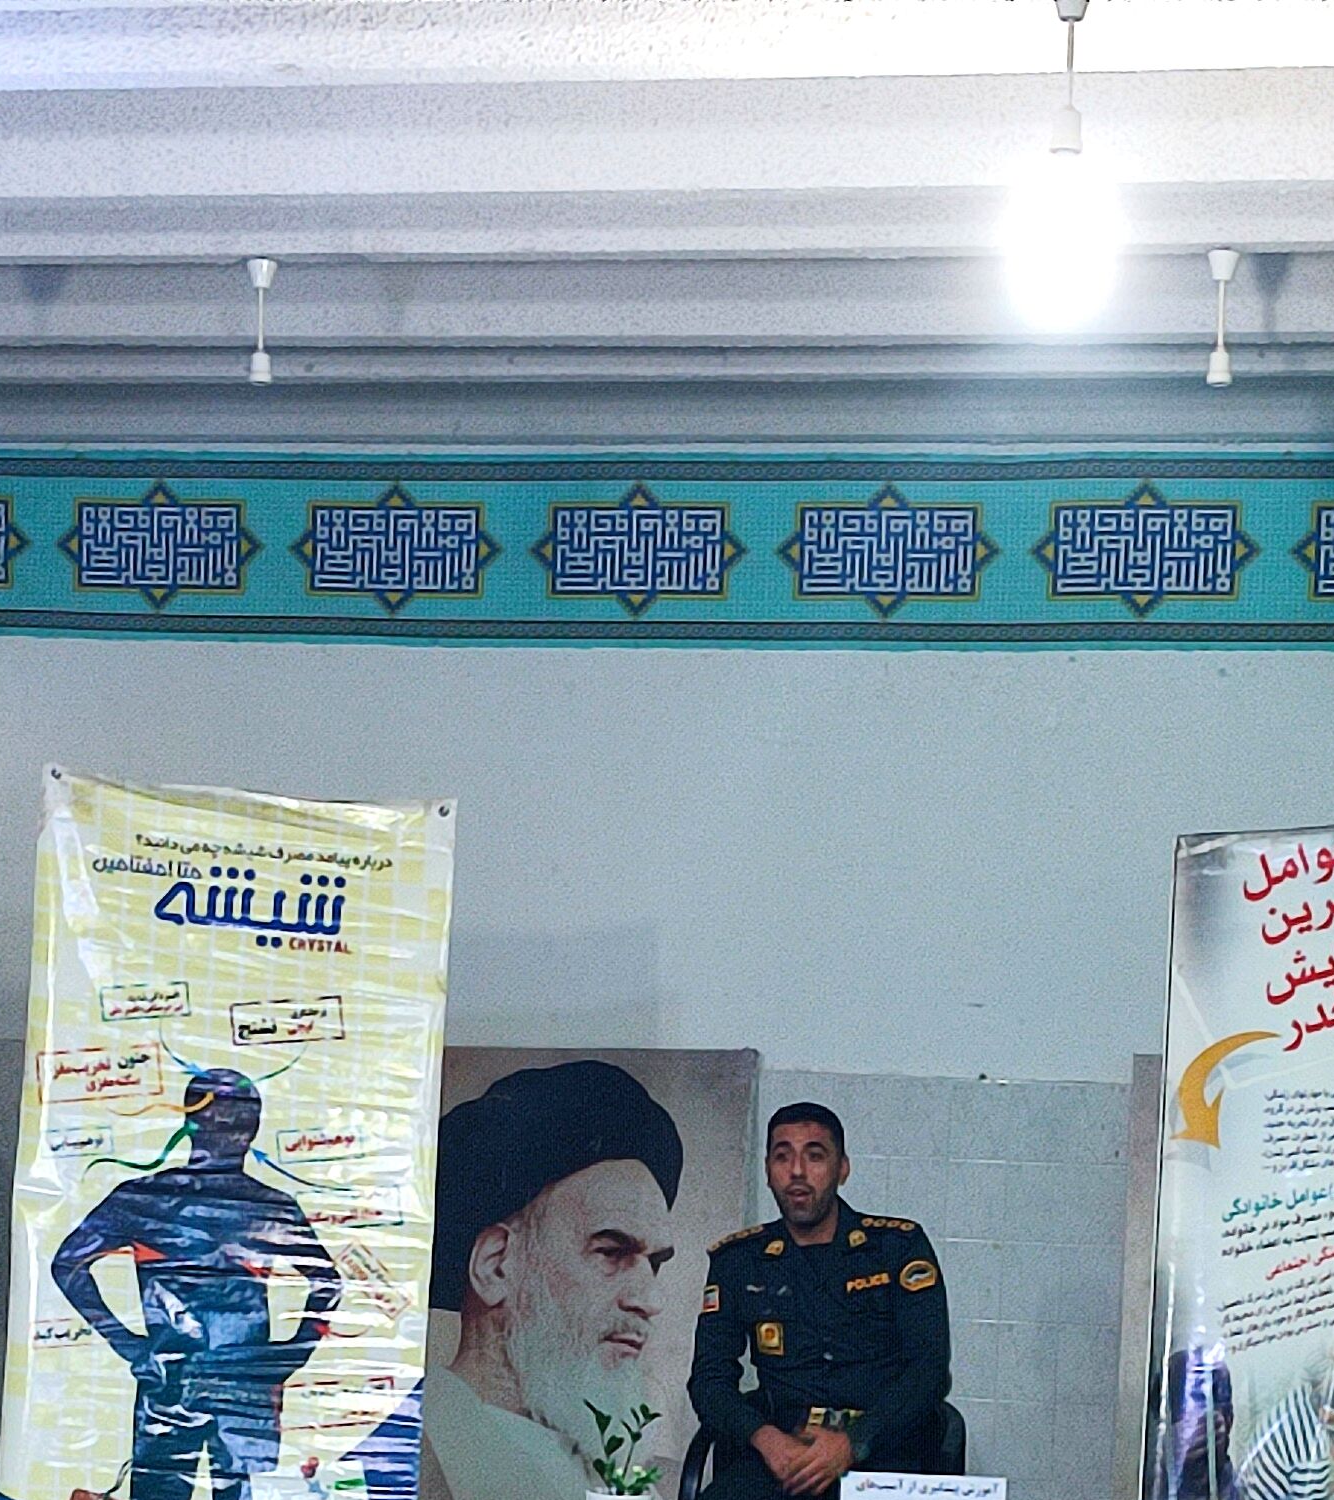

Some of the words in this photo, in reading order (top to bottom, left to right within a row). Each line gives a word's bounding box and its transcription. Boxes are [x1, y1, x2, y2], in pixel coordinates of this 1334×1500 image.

[153, 865, 348, 950] شیشه
[287, 935, 354, 956] CRYSTAL
[845, 1271, 892, 1294] POLICE
